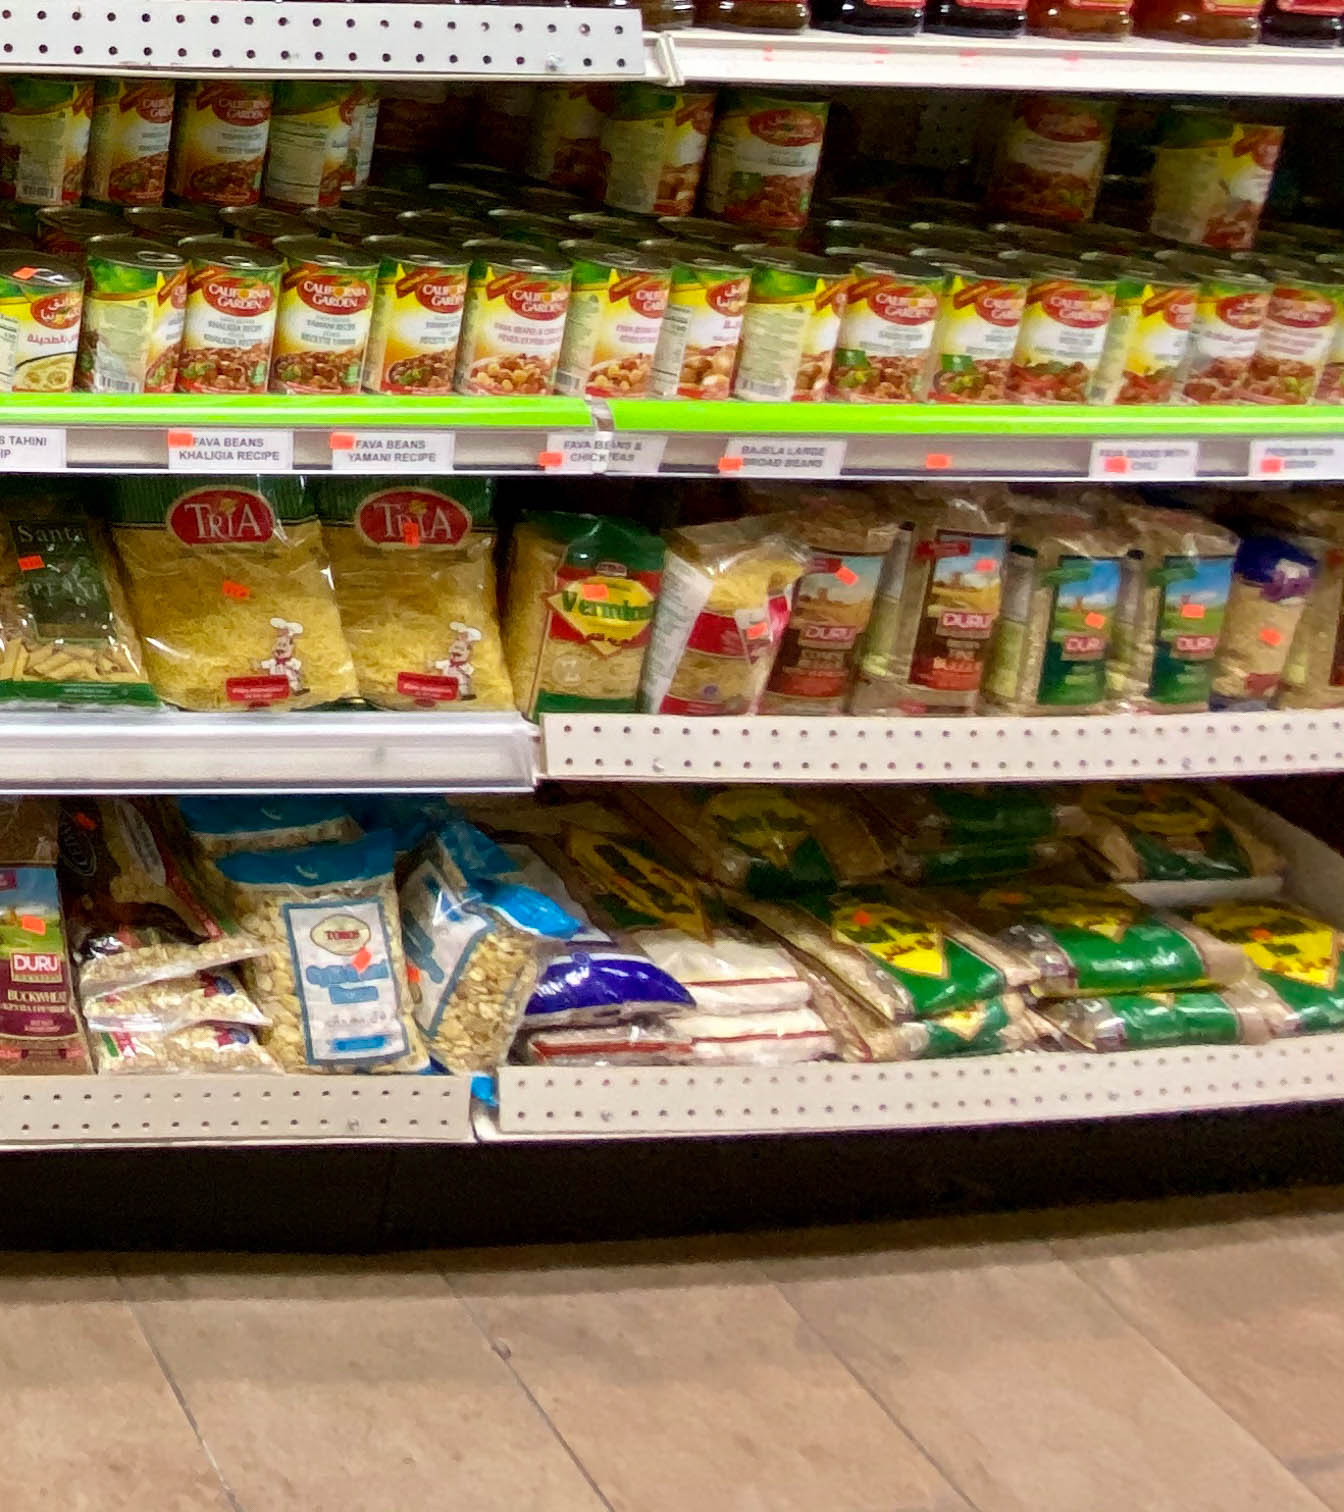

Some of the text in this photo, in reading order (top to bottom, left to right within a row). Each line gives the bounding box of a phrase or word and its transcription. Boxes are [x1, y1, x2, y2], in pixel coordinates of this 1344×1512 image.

[8, 436, 47, 448] TAHINI
[192, 437, 265, 449] FAVA BEANS
[355, 439, 427, 451] FAVA BEANS
[178, 449, 281, 462] KHALIGIA RECIPE
[348, 451, 437, 463] YAMANI RECIPE
[17, 523, 87, 545] Santa
[12, 953, 60, 973] DURU
